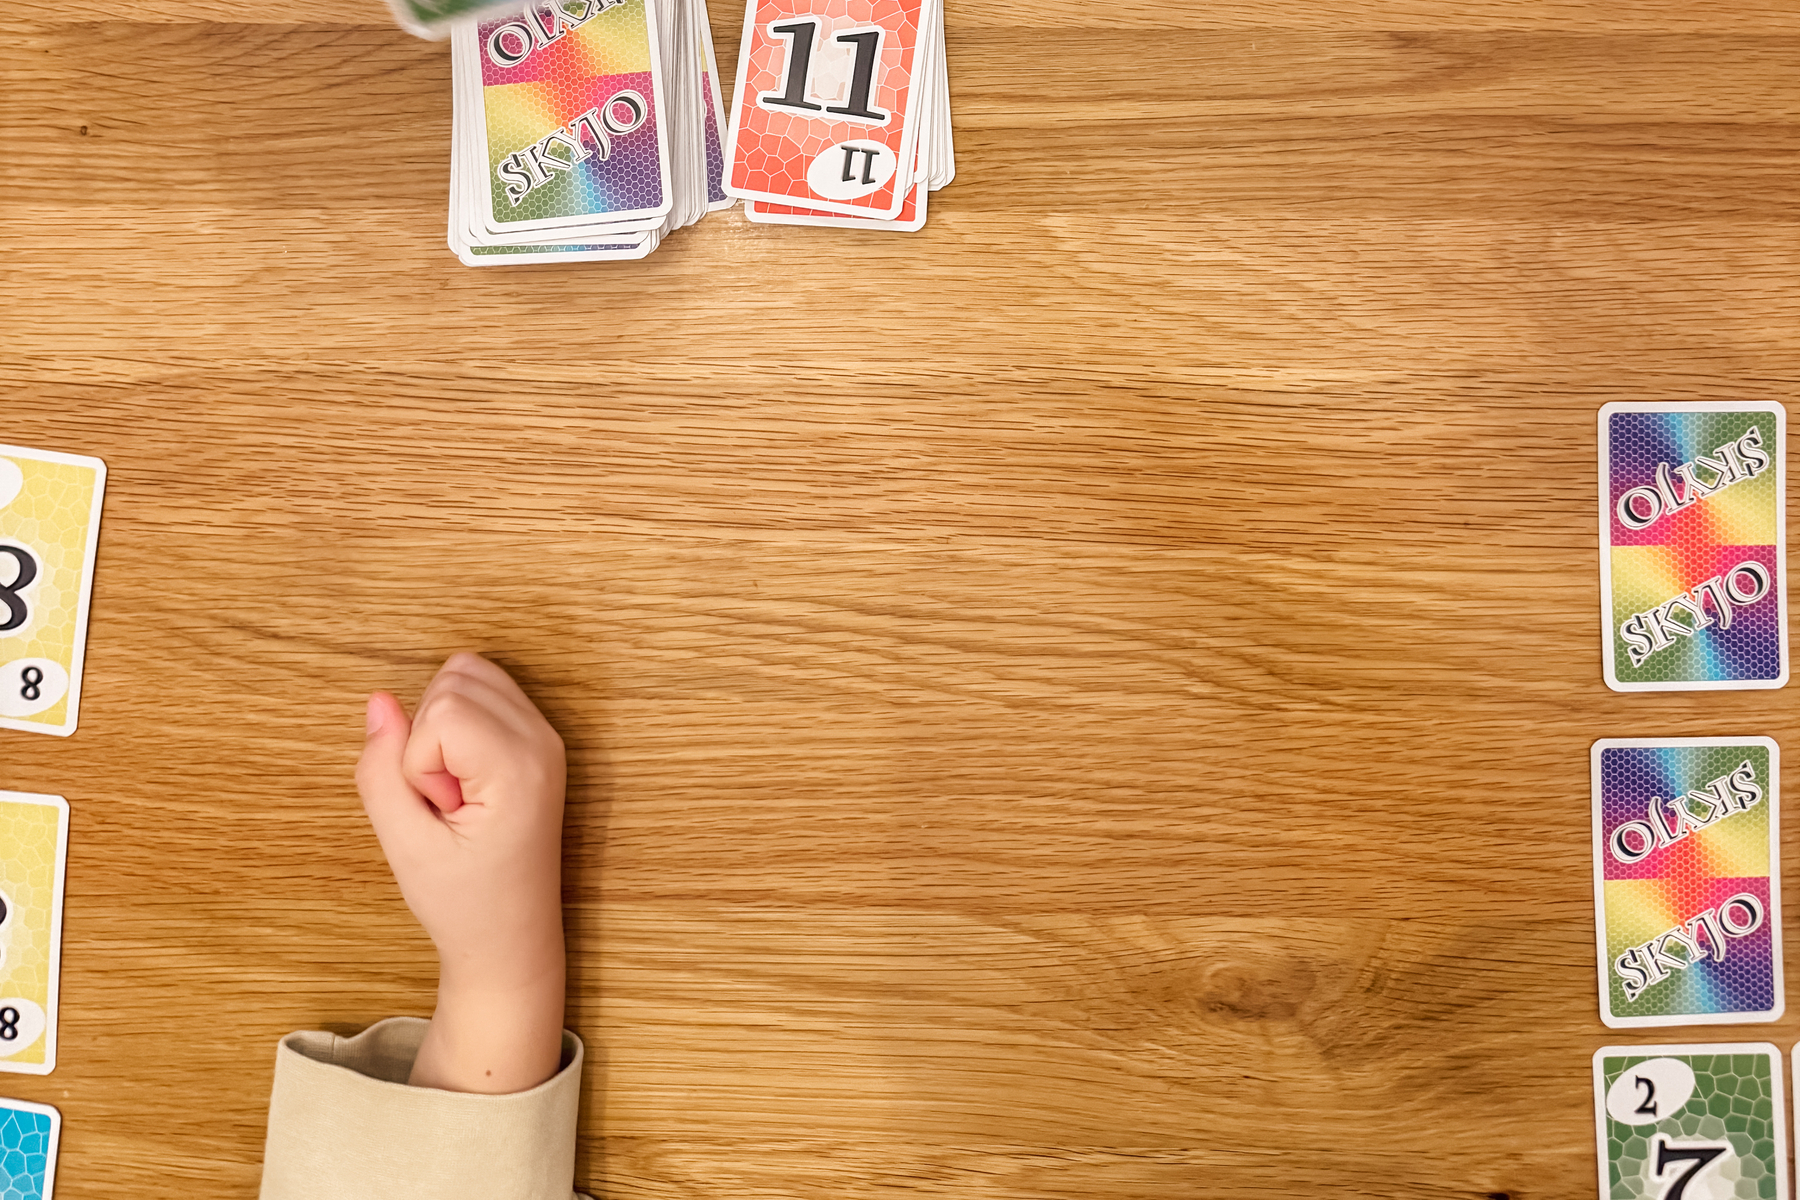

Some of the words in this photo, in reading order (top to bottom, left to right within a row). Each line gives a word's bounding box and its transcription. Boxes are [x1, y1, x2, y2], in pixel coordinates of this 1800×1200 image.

[762, 21, 886, 121] 11
[496, 89, 648, 205] SKYJO
[840, 145, 881, 185] 11
[1616, 425, 1769, 530] SKYJO
[1619, 561, 1770, 667] SKYJO
[20, 666, 44, 701] 8
[1609, 760, 1763, 864] SKYJO
[1614, 892, 1763, 1001] SKYJO
[0, 1007, 20, 1041] 8
[1634, 1075, 1658, 1117] 2
